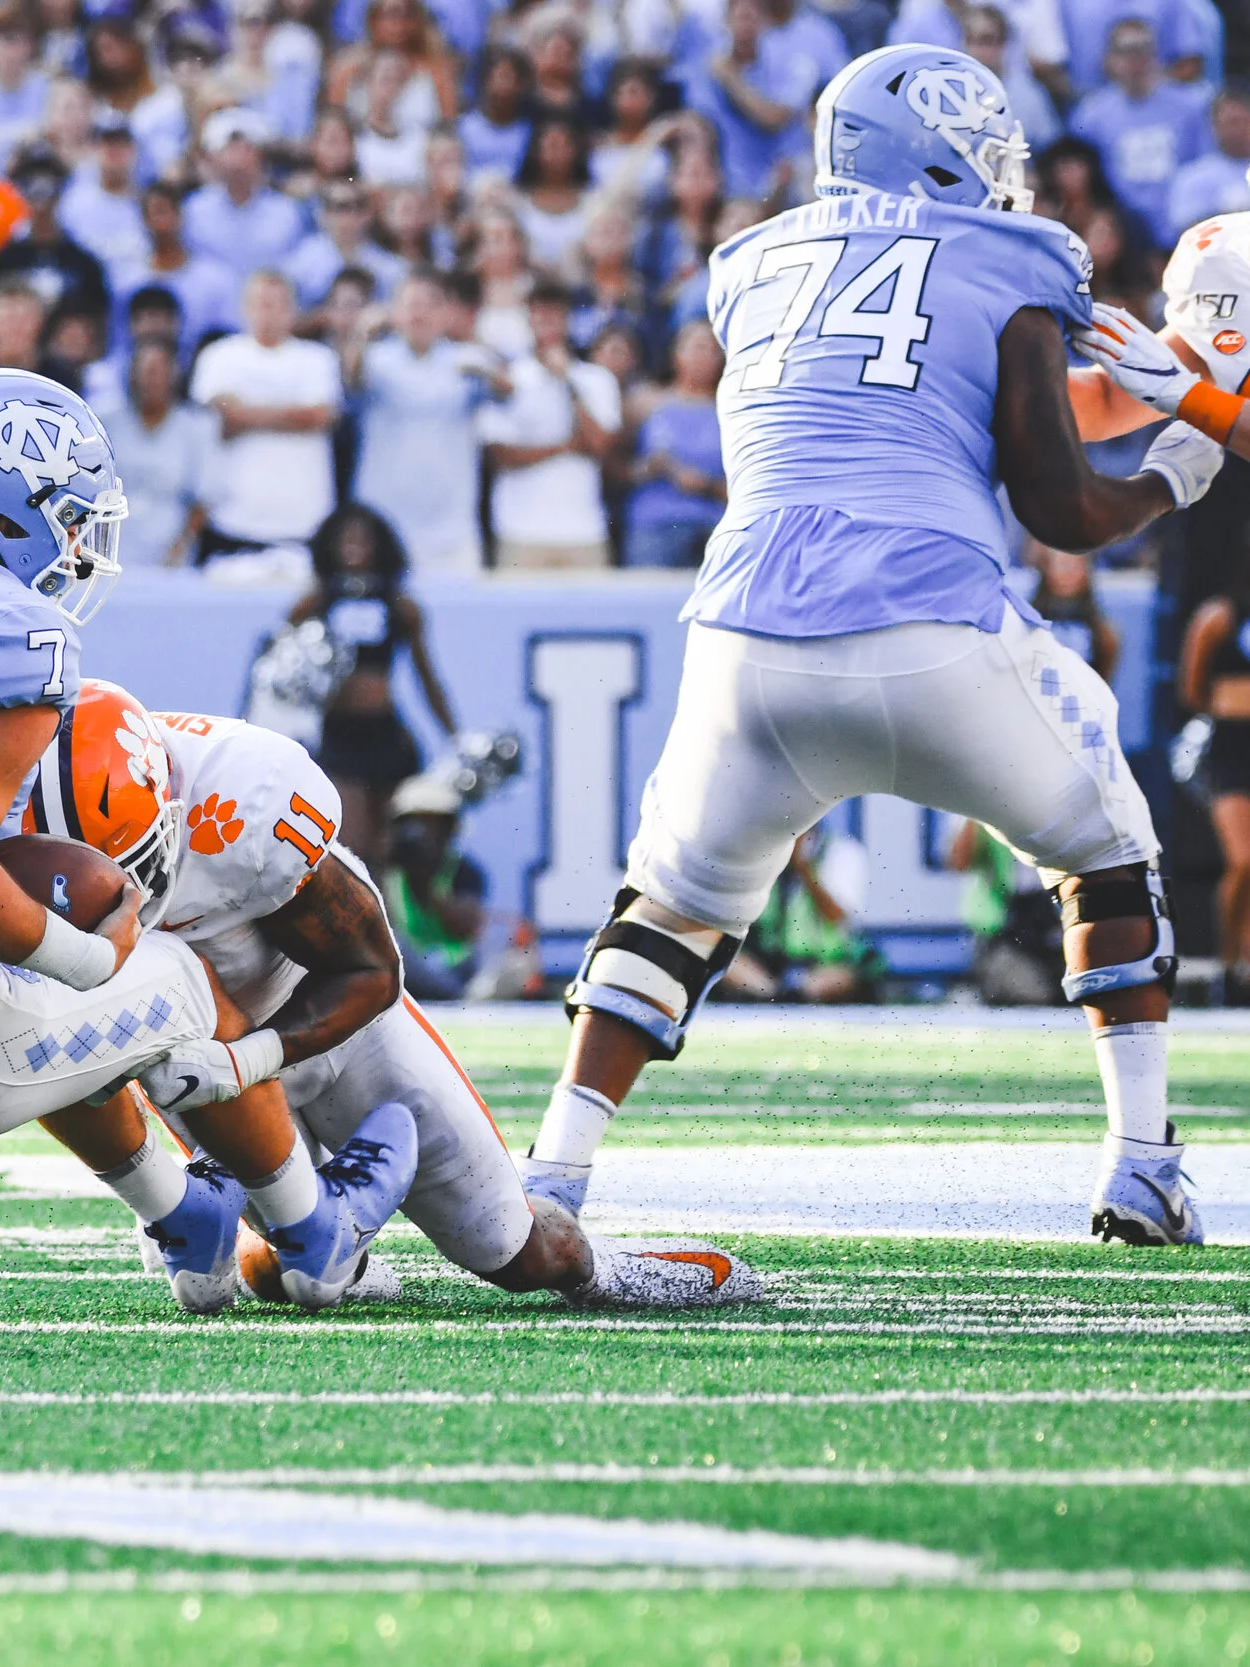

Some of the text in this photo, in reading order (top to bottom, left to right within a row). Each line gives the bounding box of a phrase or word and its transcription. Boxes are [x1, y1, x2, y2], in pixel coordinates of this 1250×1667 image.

[794, 192, 928, 232] TUCKER
[740, 235, 941, 393] 74
[27, 628, 67, 697] 7
[273, 791, 336, 868] 11
